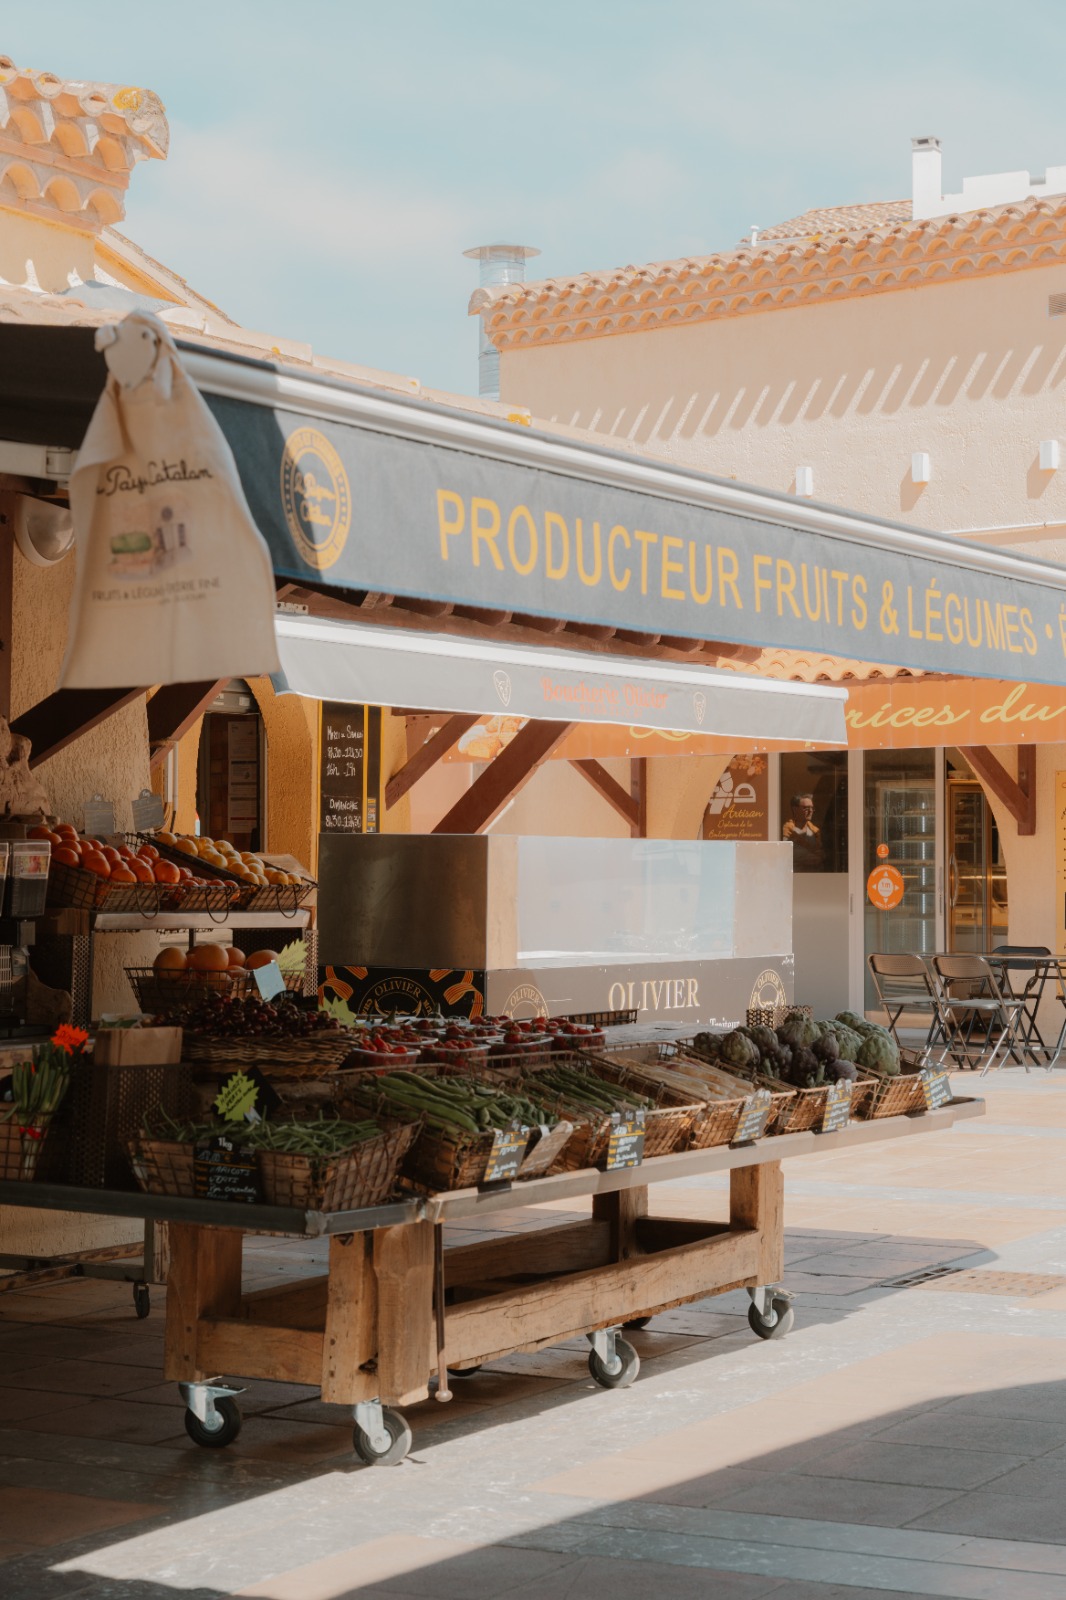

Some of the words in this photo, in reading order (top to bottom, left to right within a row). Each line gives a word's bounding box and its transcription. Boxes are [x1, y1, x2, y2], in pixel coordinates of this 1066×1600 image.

[437, 489, 743, 609] PRODUCTEUR
[753, 555, 867, 630] FRUITS
[880, 580, 899, 636] &
[907, 578, 1037, 655] LÉGUMES
[541, 676, 621, 705] Boucherie
[622, 684, 669, 708] Olivier
[846, 703, 971, 728] rices
[722, 804, 763, 819] Artisan
[374, 980, 421, 998] OLIVIER
[510, 987, 541, 1006] OLIVIER
[608, 978, 700, 1011] OLIVIER
[218, 1137, 233, 1151] 1kg
